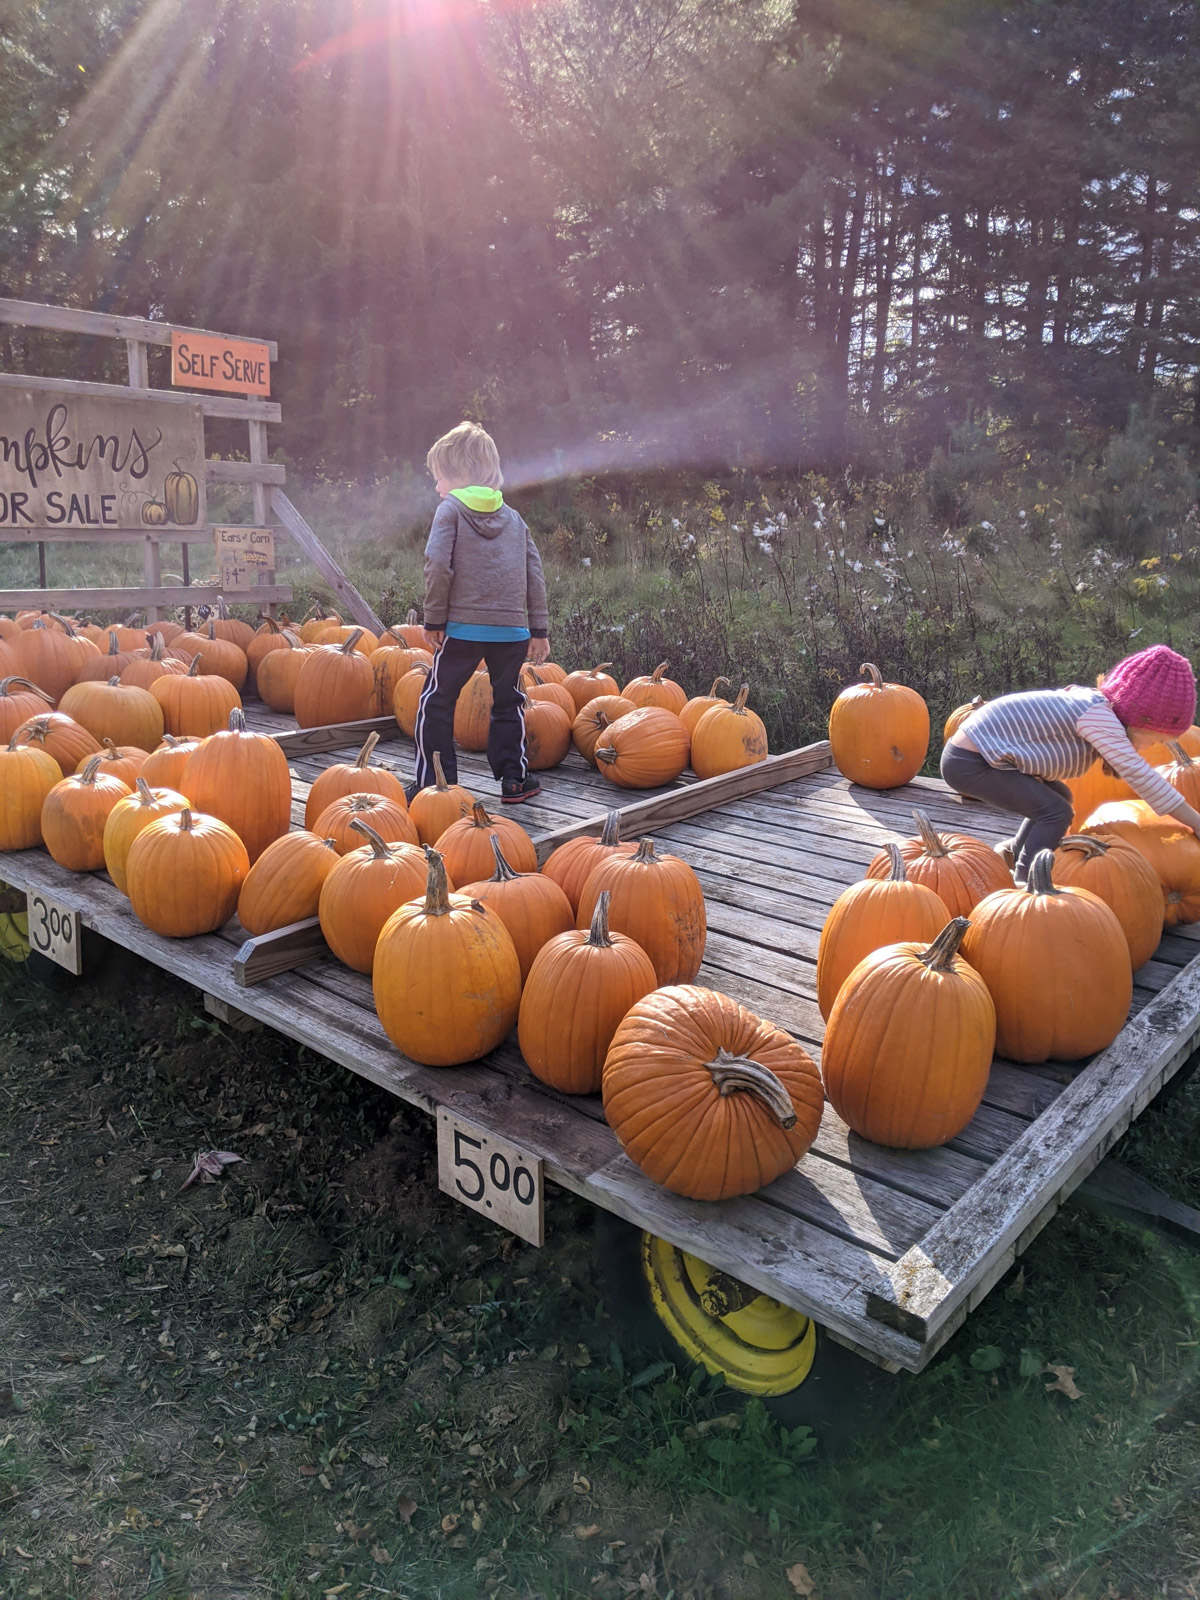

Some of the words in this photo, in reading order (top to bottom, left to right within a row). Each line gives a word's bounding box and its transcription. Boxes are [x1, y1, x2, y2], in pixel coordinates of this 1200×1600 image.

[178, 344, 219, 378] SELF
[222, 350, 266, 385] SERVE
[46, 491, 118, 524] SALE
[221, 530, 241, 542] Ears
[250, 531, 270, 544] Corn
